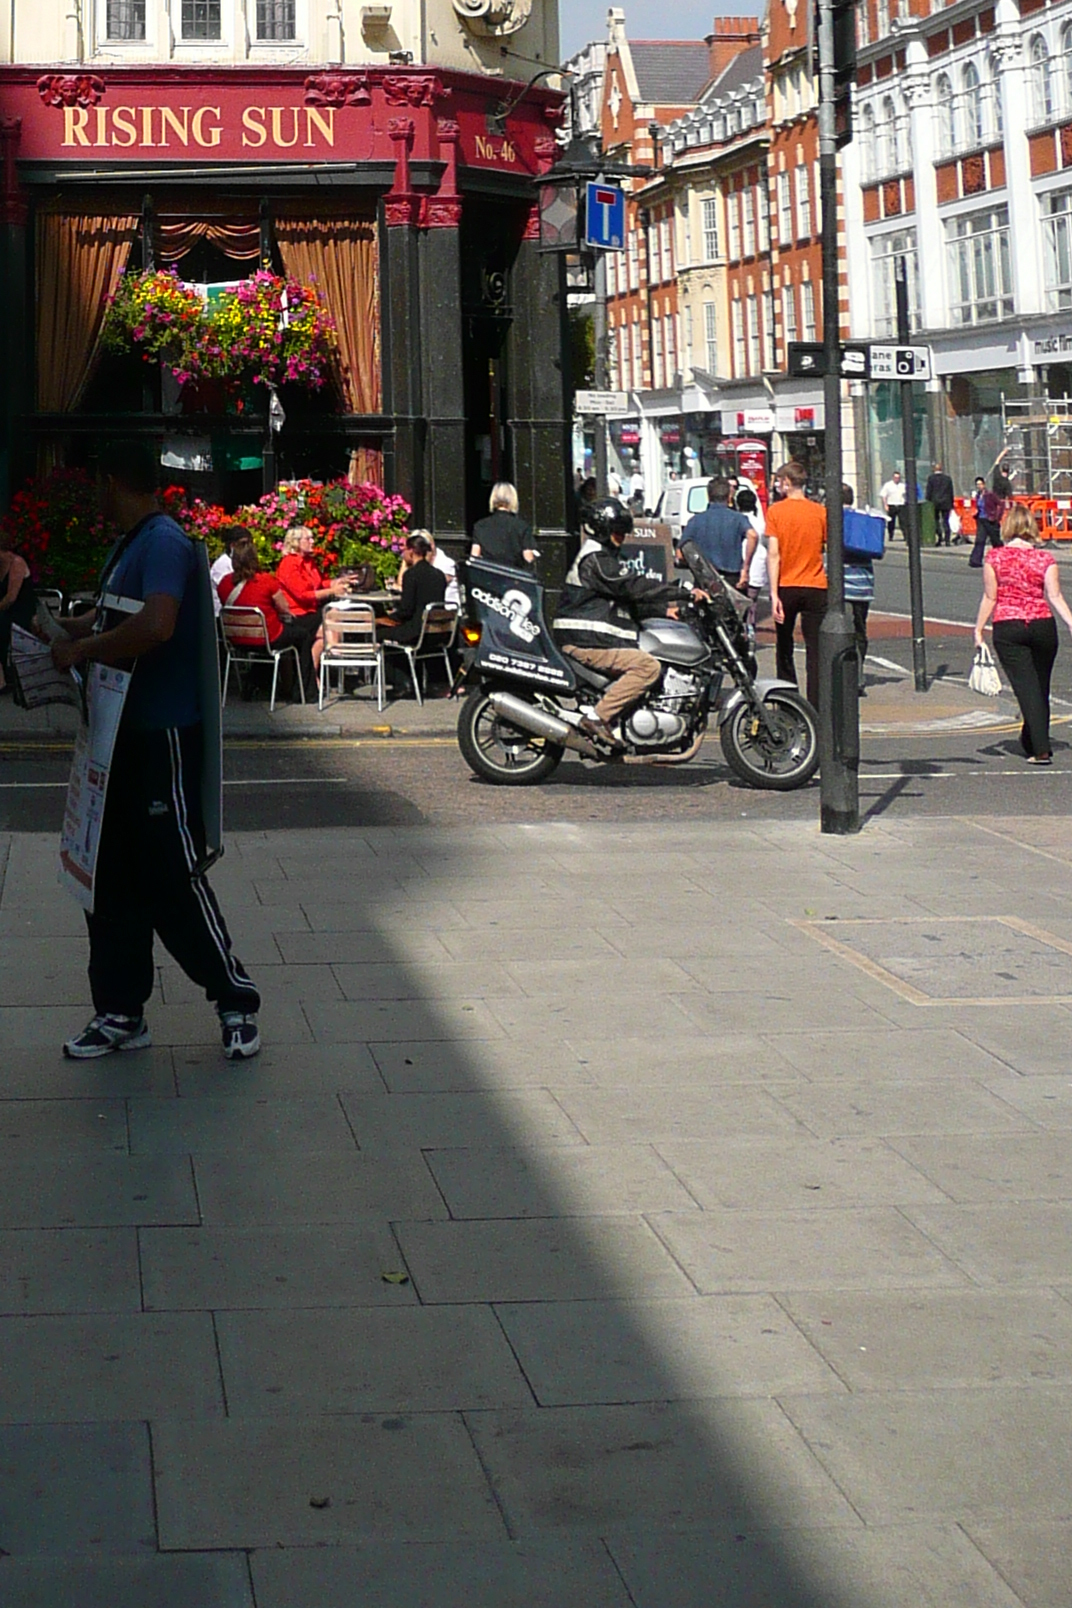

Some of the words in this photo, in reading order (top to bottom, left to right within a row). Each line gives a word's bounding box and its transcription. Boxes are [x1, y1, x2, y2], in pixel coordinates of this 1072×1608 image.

[60, 105, 225, 147] RISING
[241, 105, 337, 147] SUN
[871, 350, 893, 361] ane
[633, 527, 657, 539] SUN
[470, 587, 517, 622] addison
